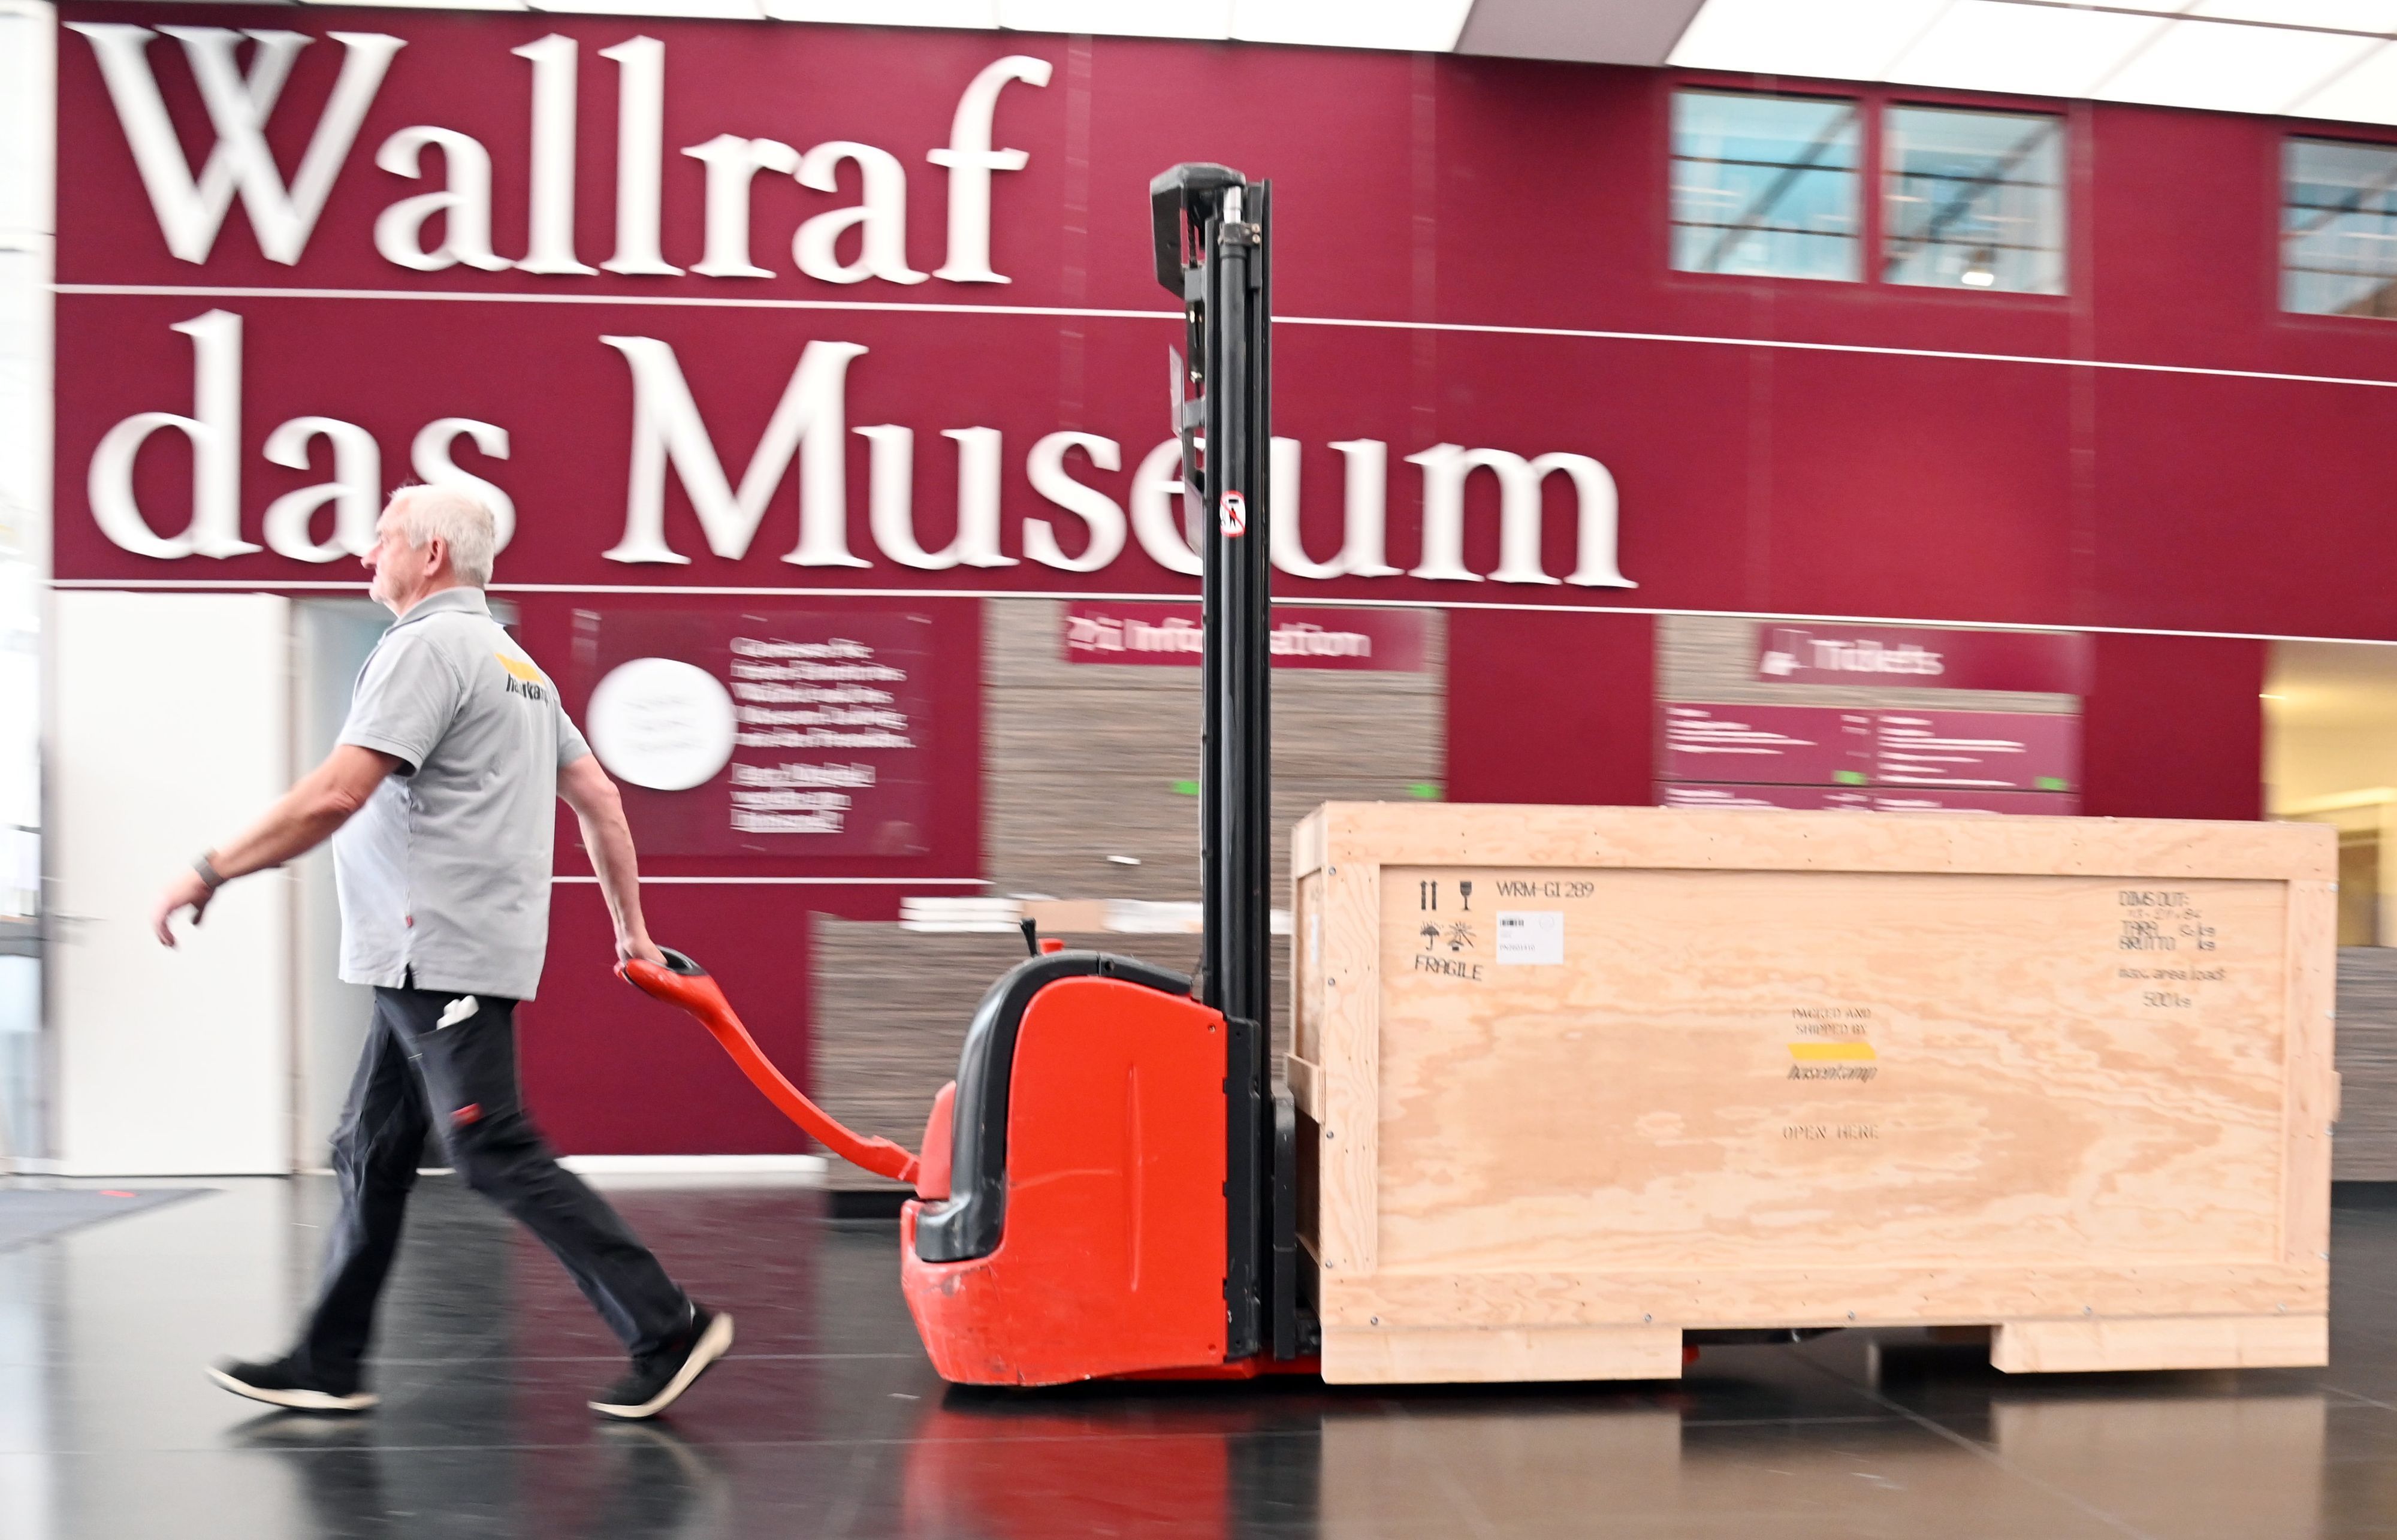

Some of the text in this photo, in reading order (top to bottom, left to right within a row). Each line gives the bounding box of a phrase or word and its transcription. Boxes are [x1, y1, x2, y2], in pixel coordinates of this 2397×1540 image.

[62, 22, 1053, 285] Wallraf
[87, 308, 1640, 589] das Museum
[1123, 617, 1372, 657] Infoation
[1807, 638, 1945, 675] Tickets
[1414, 954, 1484, 982] FRAGILE
[1792, 1007, 1872, 1019] PACKED AND
[1795, 1023, 1867, 1035] SHIPPED BY
[1783, 1125, 1879, 1140] OPEN HERE
